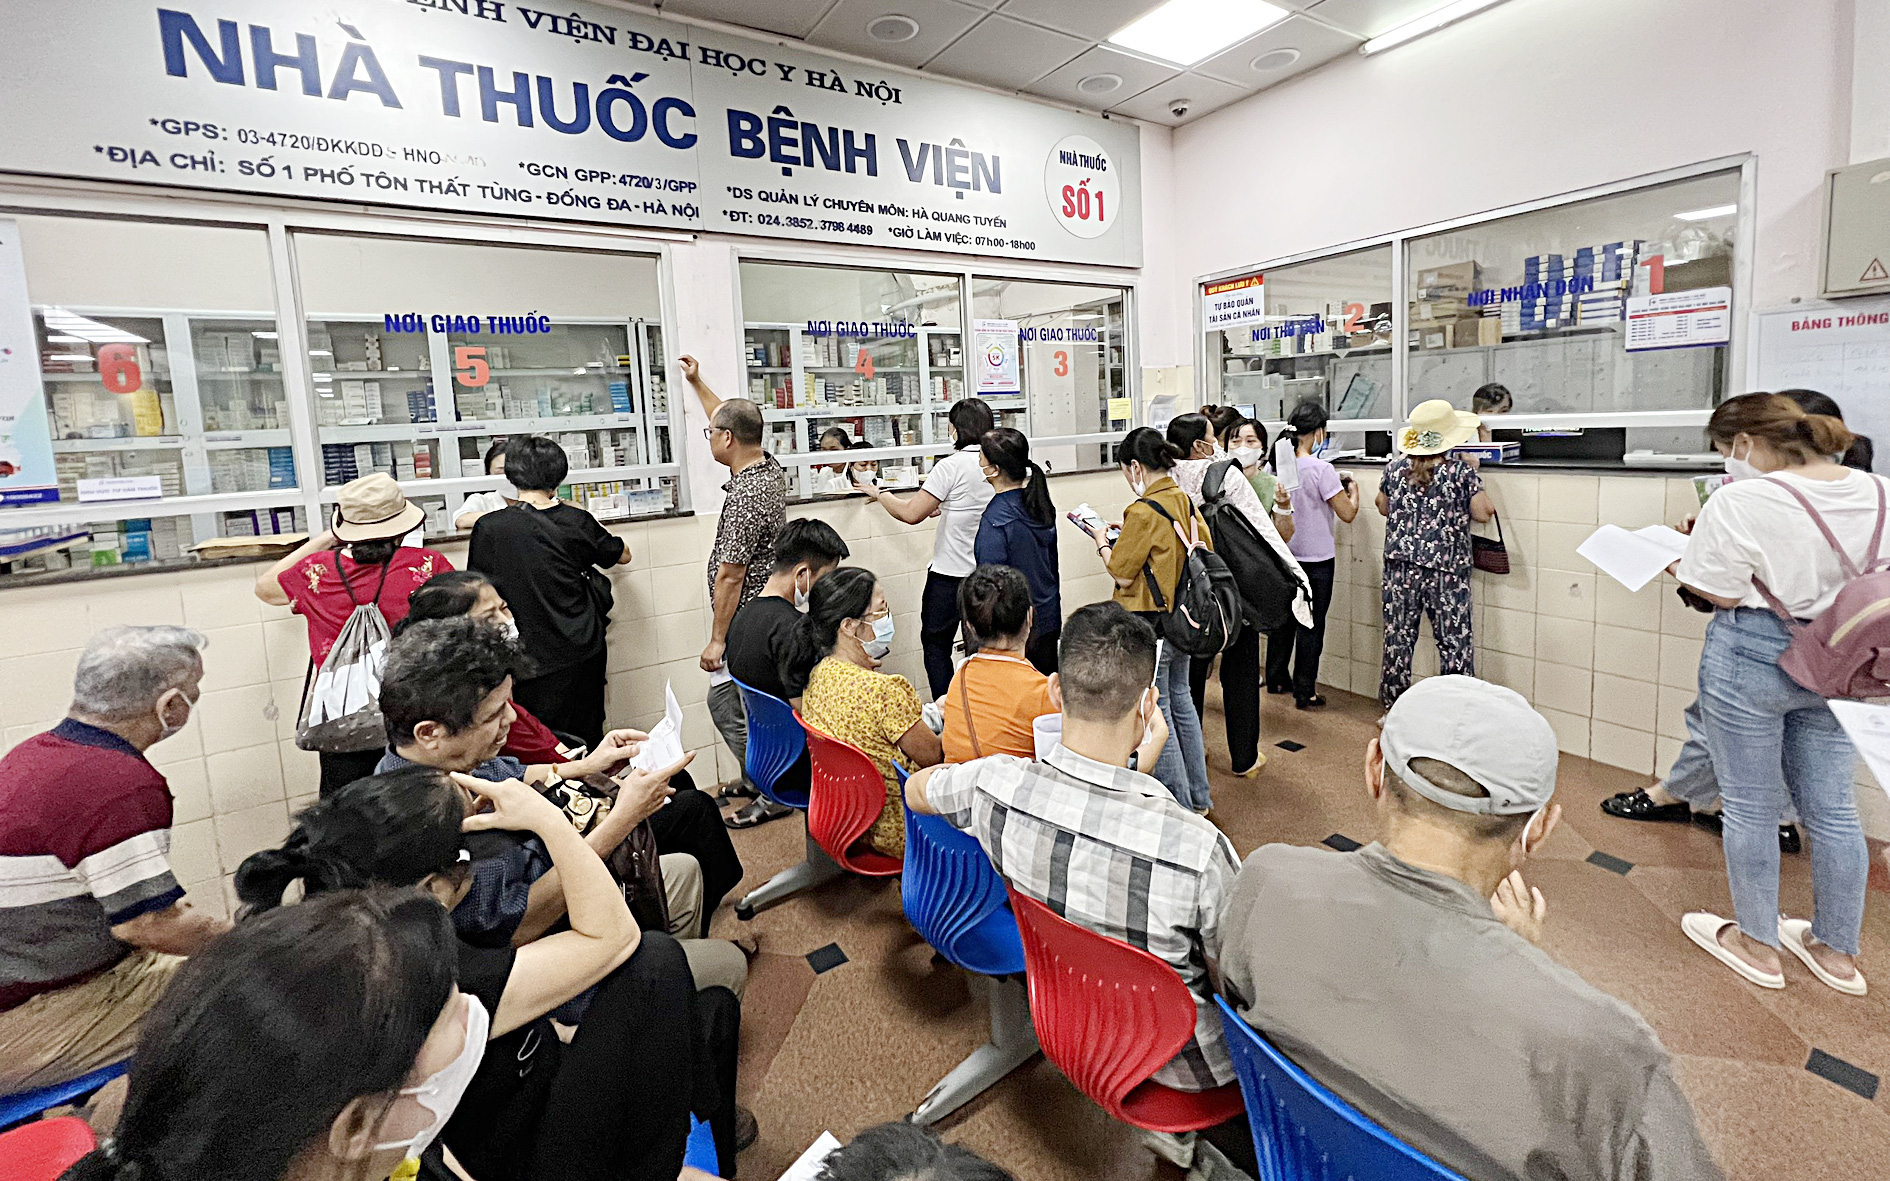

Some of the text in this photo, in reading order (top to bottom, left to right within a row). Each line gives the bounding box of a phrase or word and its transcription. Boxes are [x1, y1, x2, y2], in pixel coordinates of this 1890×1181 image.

[516, 7, 617, 45] VIỆN
[627, 30, 691, 61] ĐẠI
[698, 46, 767, 77] HỌC
[775, 62, 796, 82] Y
[805, 69, 848, 93] HÀ
[854, 80, 902, 106] NỘI
[157, 7, 1001, 200] NHÀ THUỐC BỆNH VIỆN
[1060, 150, 1106, 172] NHÀ THUỐC
[169, 150, 225, 174] CHỈ:
[237, 155, 275, 179] SỐ
[282, 164, 293, 180] 1
[303, 164, 355, 187] PHỐ
[359, 170, 408, 191] TÔN
[414, 173, 470, 197] THẤT
[477, 181, 532, 203] TÙNG
[546, 187, 601, 209] ĐỐNG
[643, 197, 667, 215] HÀ
[671, 201, 700, 221] NỘI
[757, 188, 799, 206] QUẢN
[803, 192, 818, 207] LÝ
[823, 197, 874, 215] CHUYÊN
[878, 203, 909, 219] MÔN:
[912, 205, 929, 220] HÀ
[931, 211, 970, 225] QUANG
[973, 213, 1007, 229] TUYẾN
[1062, 178, 1104, 222] SỐ 1
[917, 226, 942, 242] LÀM
[945, 232, 972, 246] VIỆC:
[1640, 254, 1665, 294] 1
[1236, 296, 1254, 308] QUẢN
[384, 310, 551, 334] NƠI GIAO THUỐC
[807, 318, 916, 338] NƠI GIAO THUỐC
[1219, 312, 1231, 322] SẢN
[1344, 303, 1364, 332] 2
[1791, 312, 1889, 331] BẢNG THÔNG
[1019, 323, 1097, 341] NƠI GIAO THUỐC
[1252, 326, 1271, 341] NƠI
[98, 343, 142, 394] 6
[454, 346, 491, 387] 5
[855, 348, 876, 380] 4
[1053, 350, 1069, 377] 3
